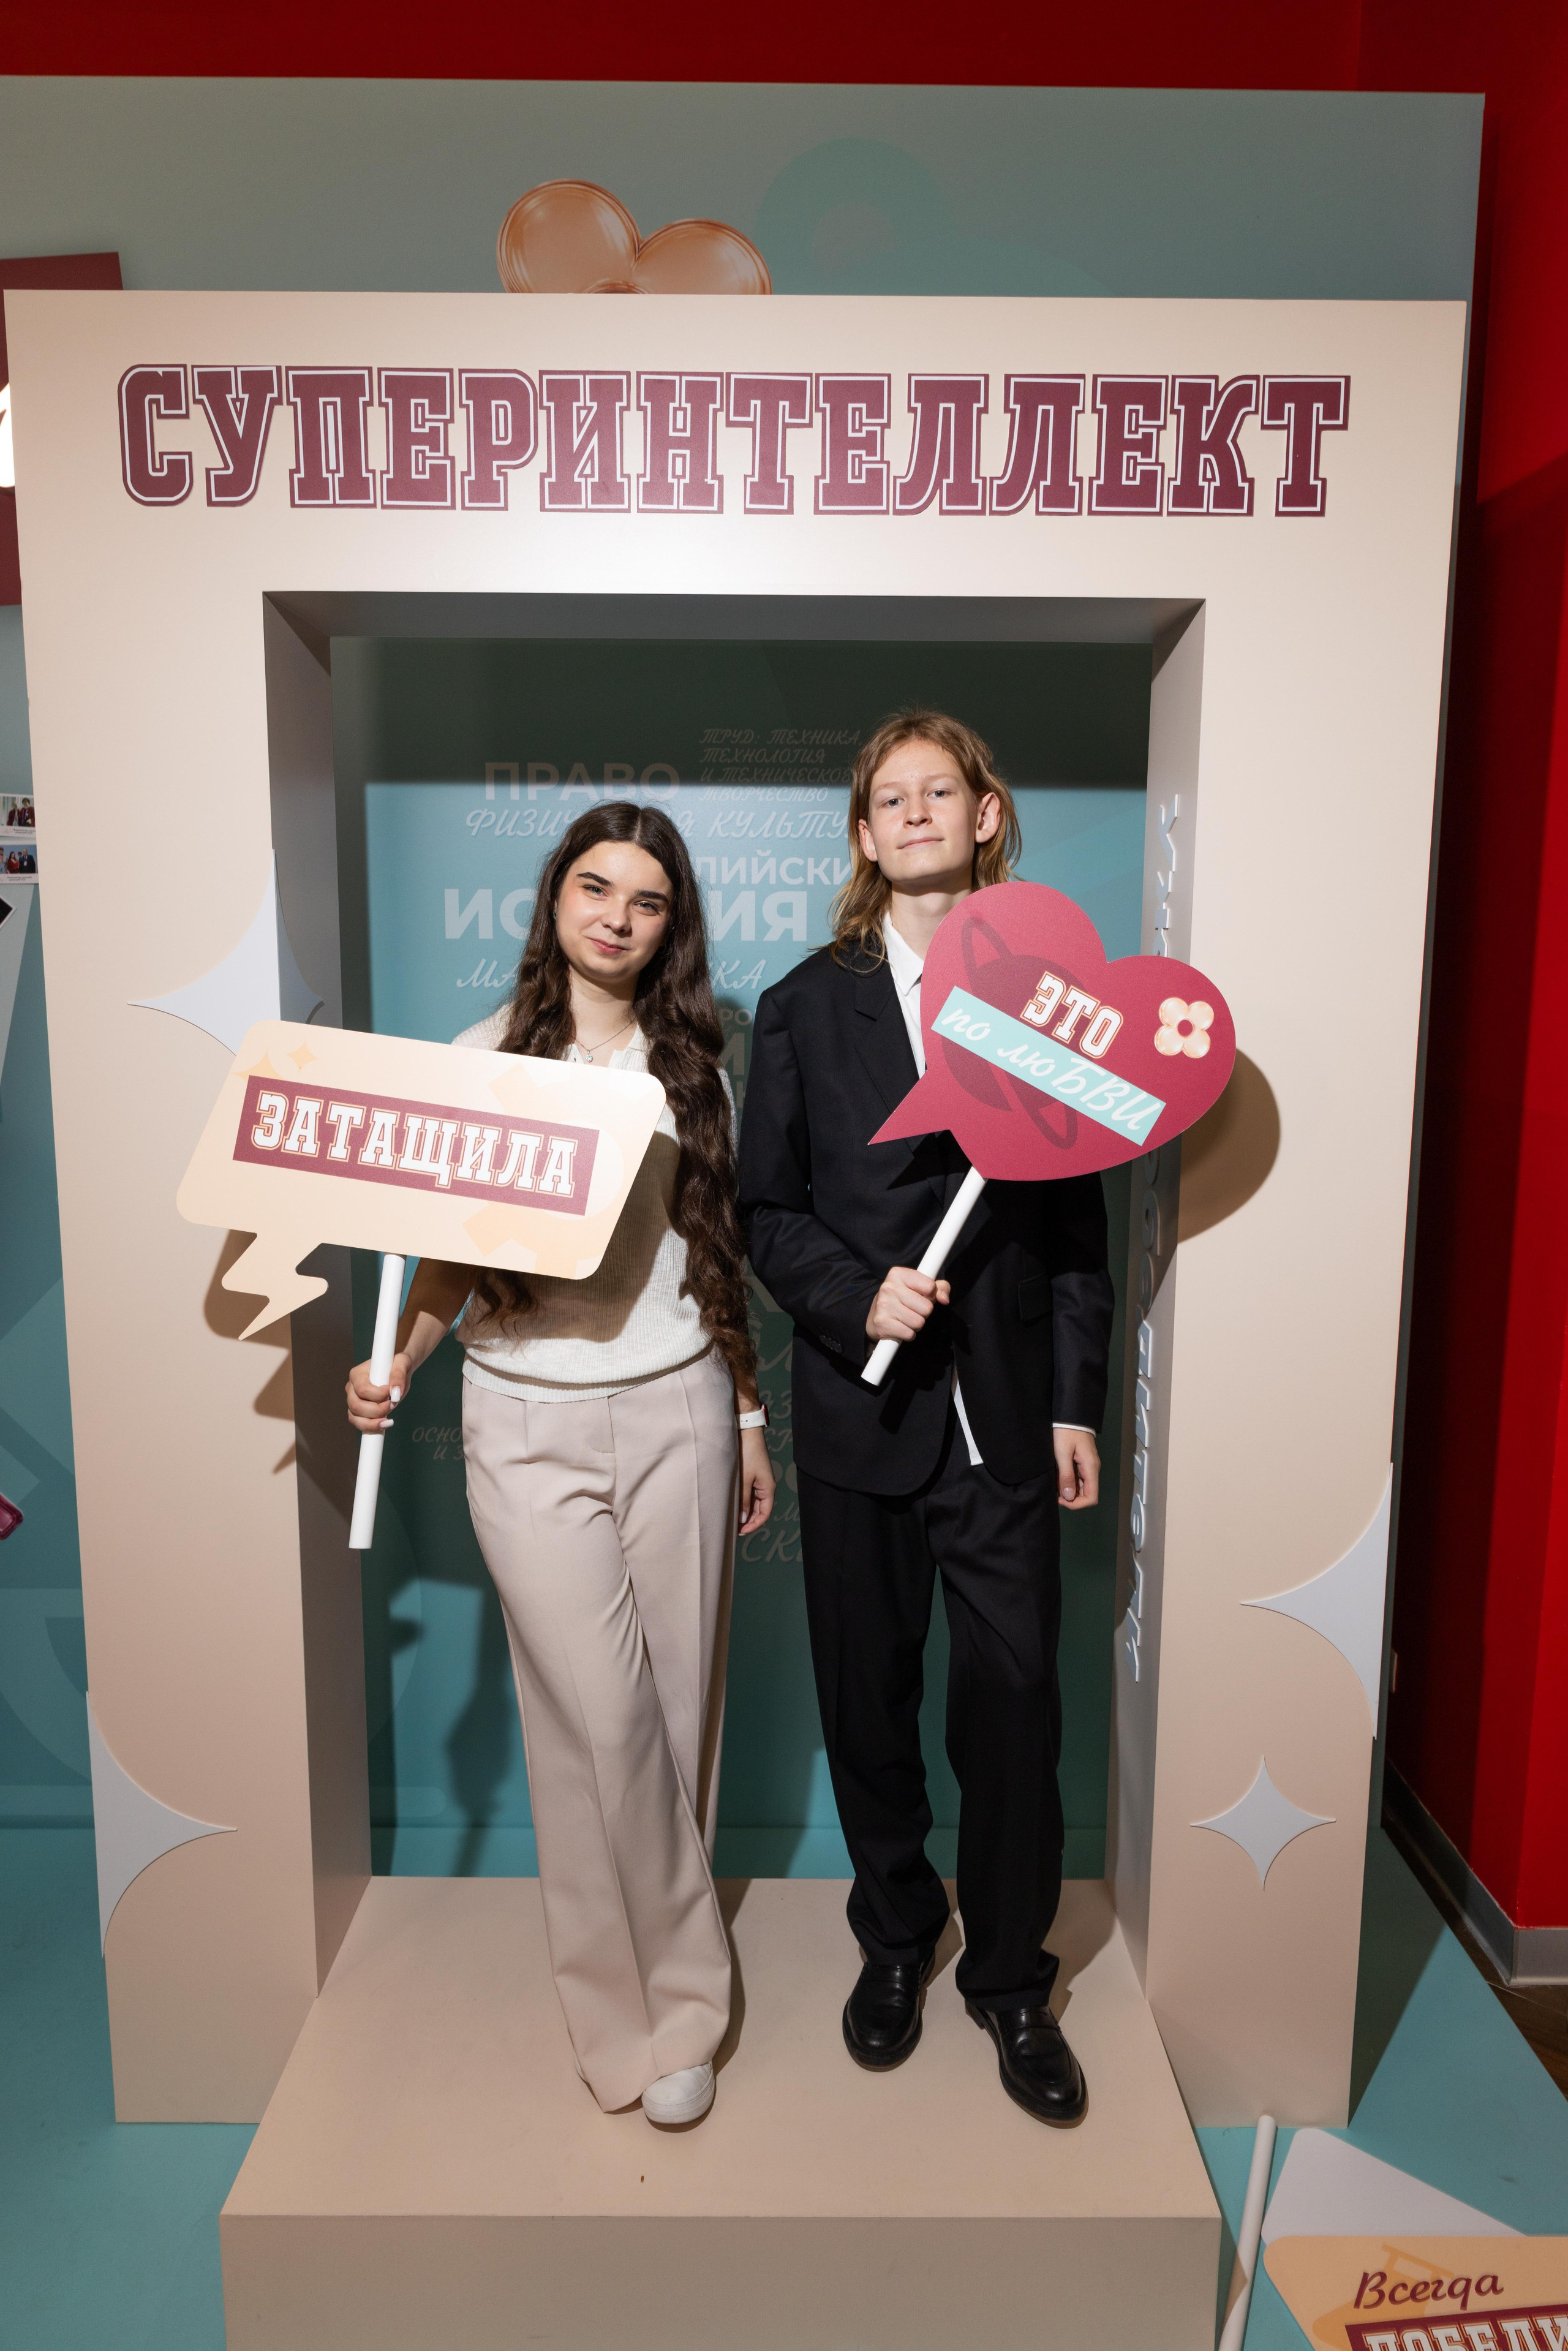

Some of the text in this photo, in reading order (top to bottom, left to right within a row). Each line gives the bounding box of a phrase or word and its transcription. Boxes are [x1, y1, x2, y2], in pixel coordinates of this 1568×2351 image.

[117, 363, 1351, 518] СУПЕРИНТЕЛЛЕКТ
[699, 729, 760, 745] ТРУД:
[699, 748, 826, 764] ТЕХНОЛОГИЯ
[484, 762, 680, 801] ПРАВО
[701, 768, 715, 783] И
[699, 787, 829, 802] ТВОРЧЕСТВО
[707, 810, 850, 839] КУЛЬТУ
[1020, 970, 1124, 1059] ЭТО
[251, 1089, 579, 1198] ЗАТАЩИЛА
[1353, 2271, 1505, 2311] Всегда
